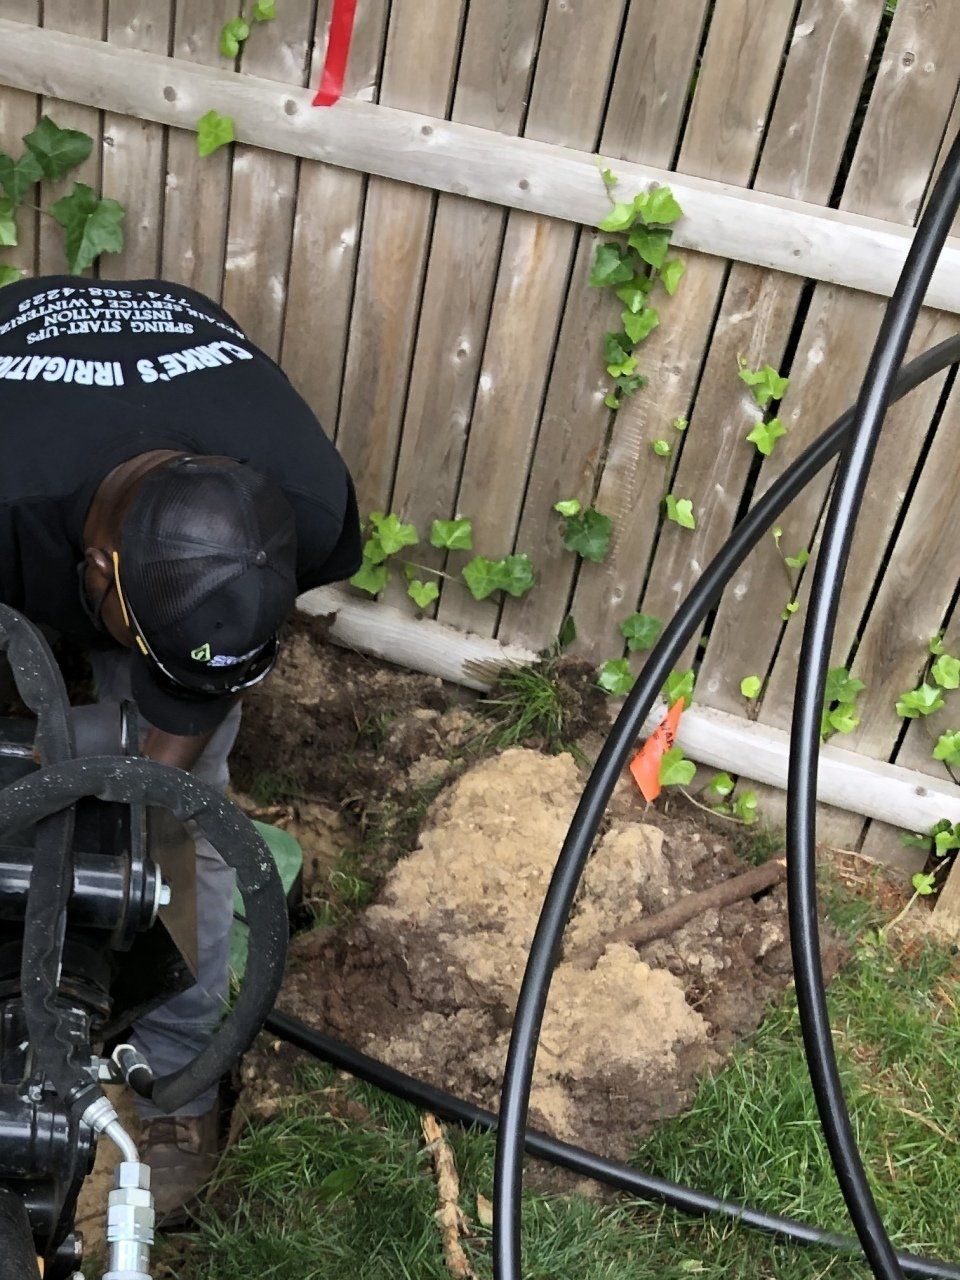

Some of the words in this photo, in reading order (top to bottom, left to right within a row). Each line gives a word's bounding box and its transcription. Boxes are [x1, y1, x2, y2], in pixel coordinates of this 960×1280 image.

[108, 299, 183, 312] SERVICE
[44, 309, 172, 327] INSTALLATION
[27, 320, 121, 344] START-UPS
[130, 321, 194, 335] SPRING
[137, 340, 254, 384] CLARKE'S
